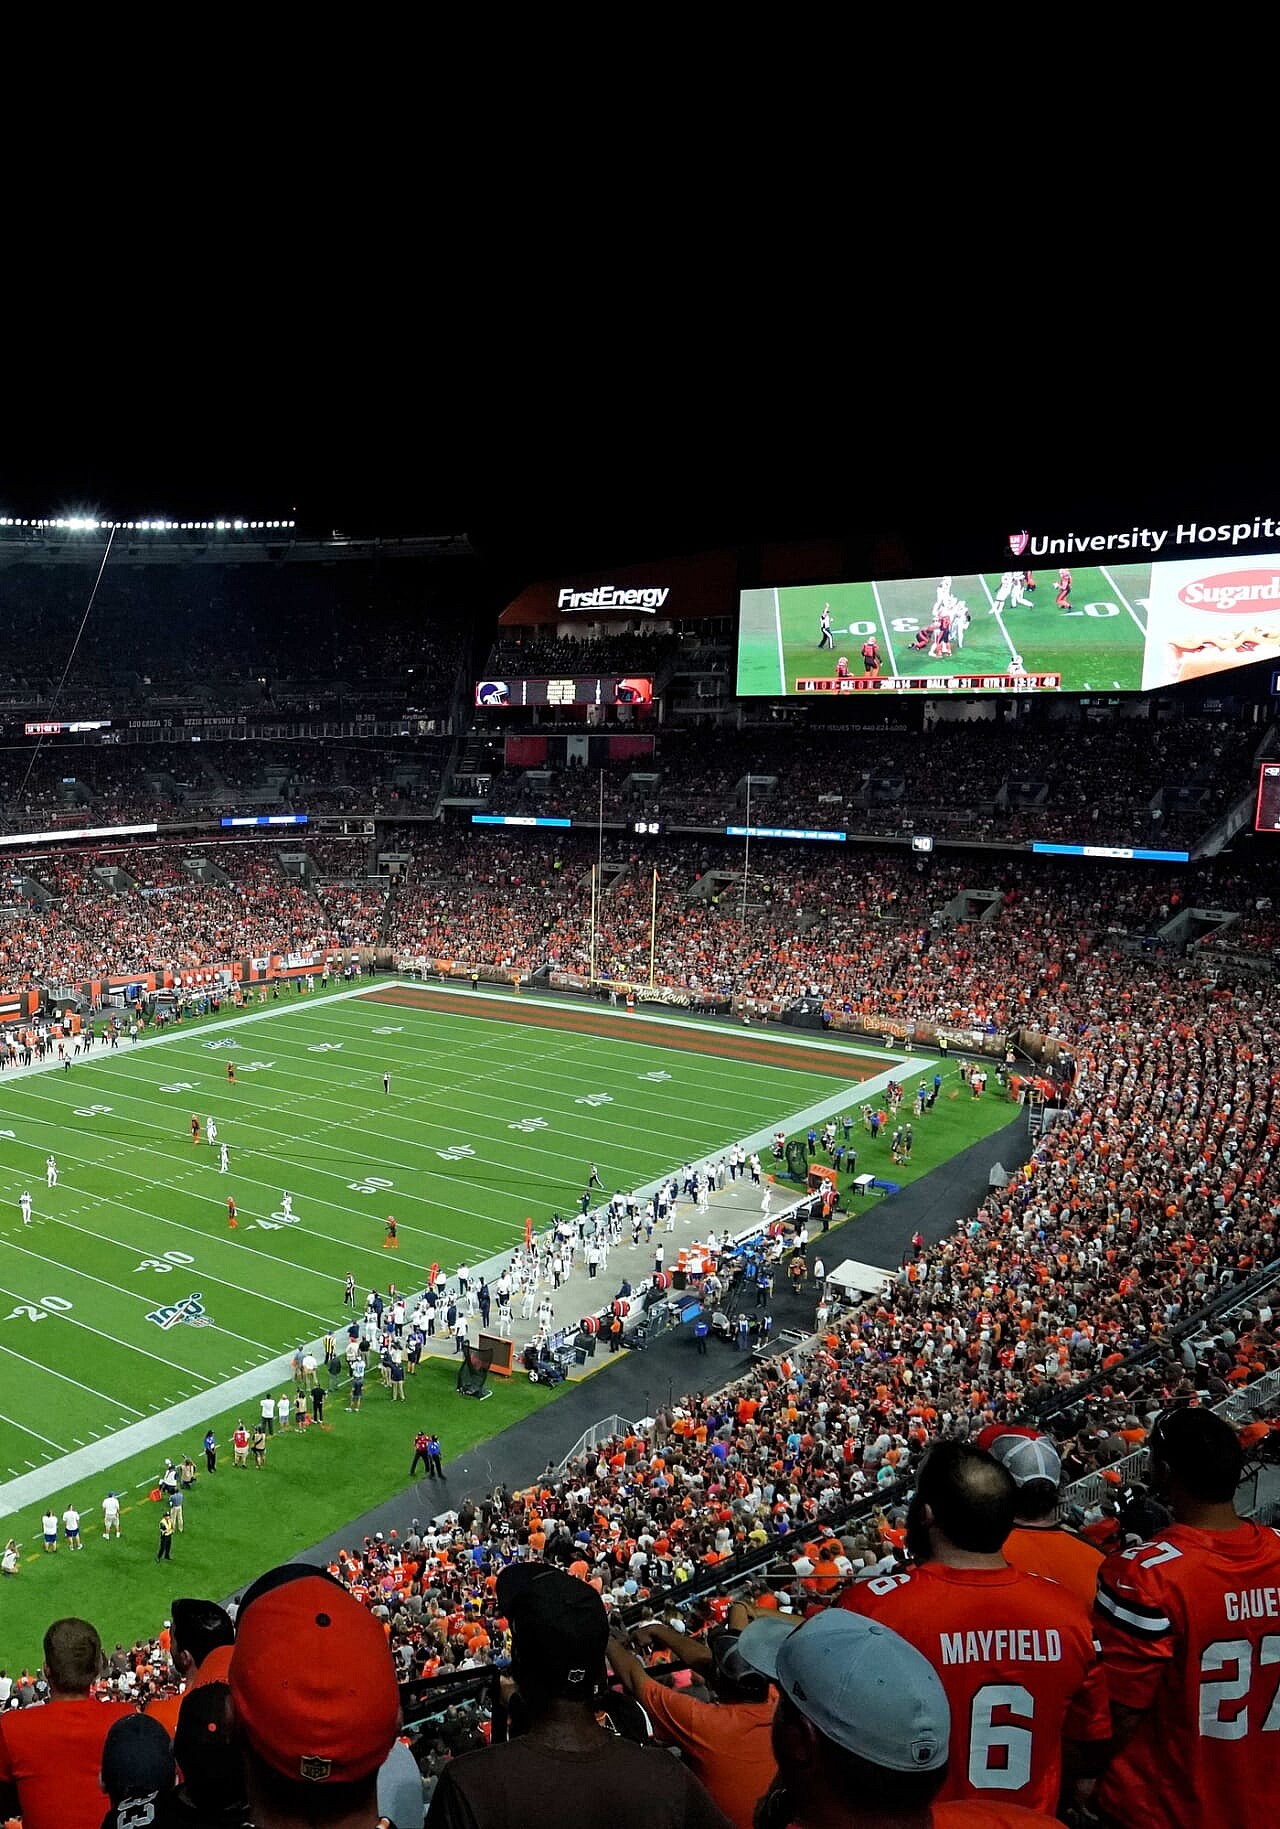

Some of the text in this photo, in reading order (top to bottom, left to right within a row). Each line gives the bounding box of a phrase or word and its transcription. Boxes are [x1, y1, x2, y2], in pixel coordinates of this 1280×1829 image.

[1030, 527, 1168, 556] University
[557, 585, 670, 608] FirstEnergy
[347, 1176, 394, 1195] 50
[141, 1250, 195, 1273] 30
[12, 1295, 73, 1322] 20
[1224, 1587, 1280, 1622] GAUE
[939, 1629, 1062, 1665] MAYFIELD
[967, 1684, 1035, 1790] 6
